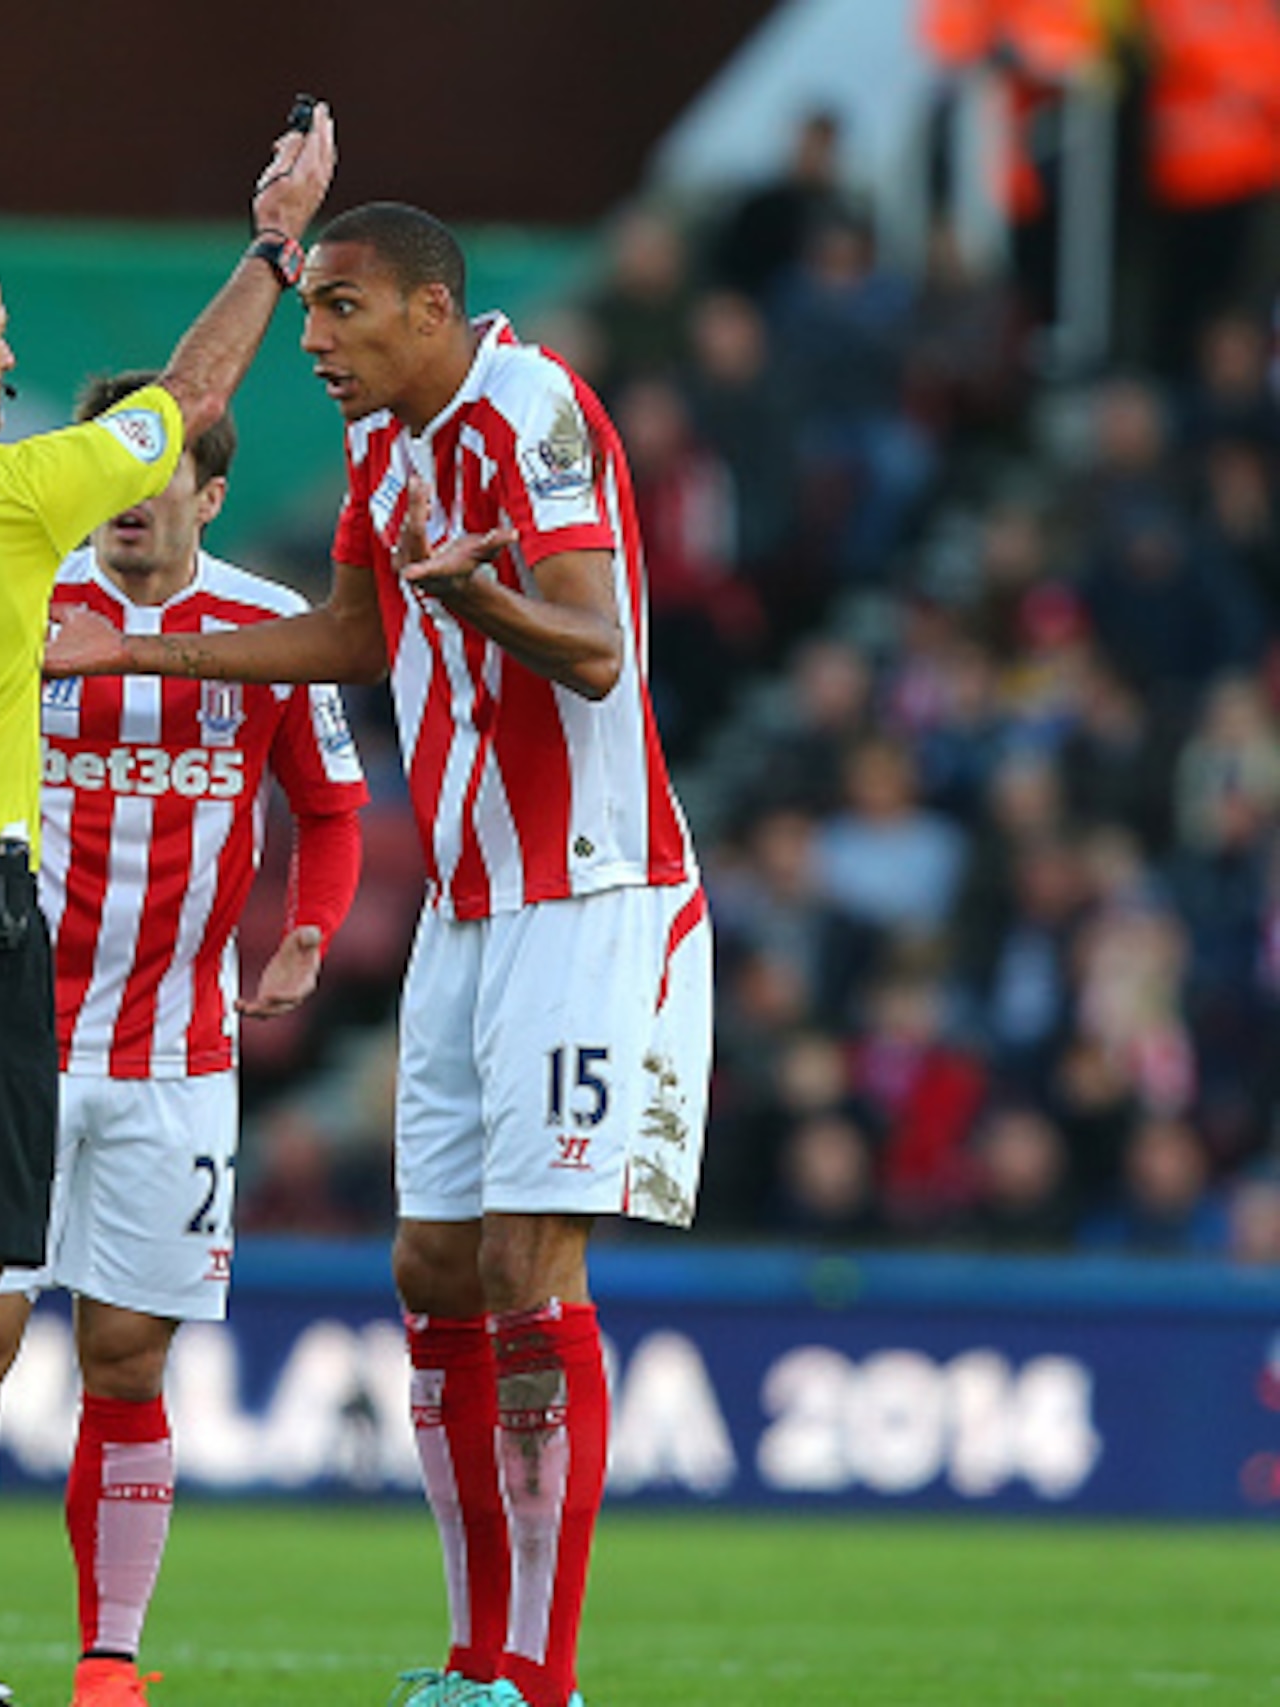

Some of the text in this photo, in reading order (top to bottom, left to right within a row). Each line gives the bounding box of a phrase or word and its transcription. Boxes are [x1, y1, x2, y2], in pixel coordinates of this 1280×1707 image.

[42, 737, 244, 797] bet365
[546, 1044, 609, 1128] 15
[757, 1344, 1102, 1498] 2014
